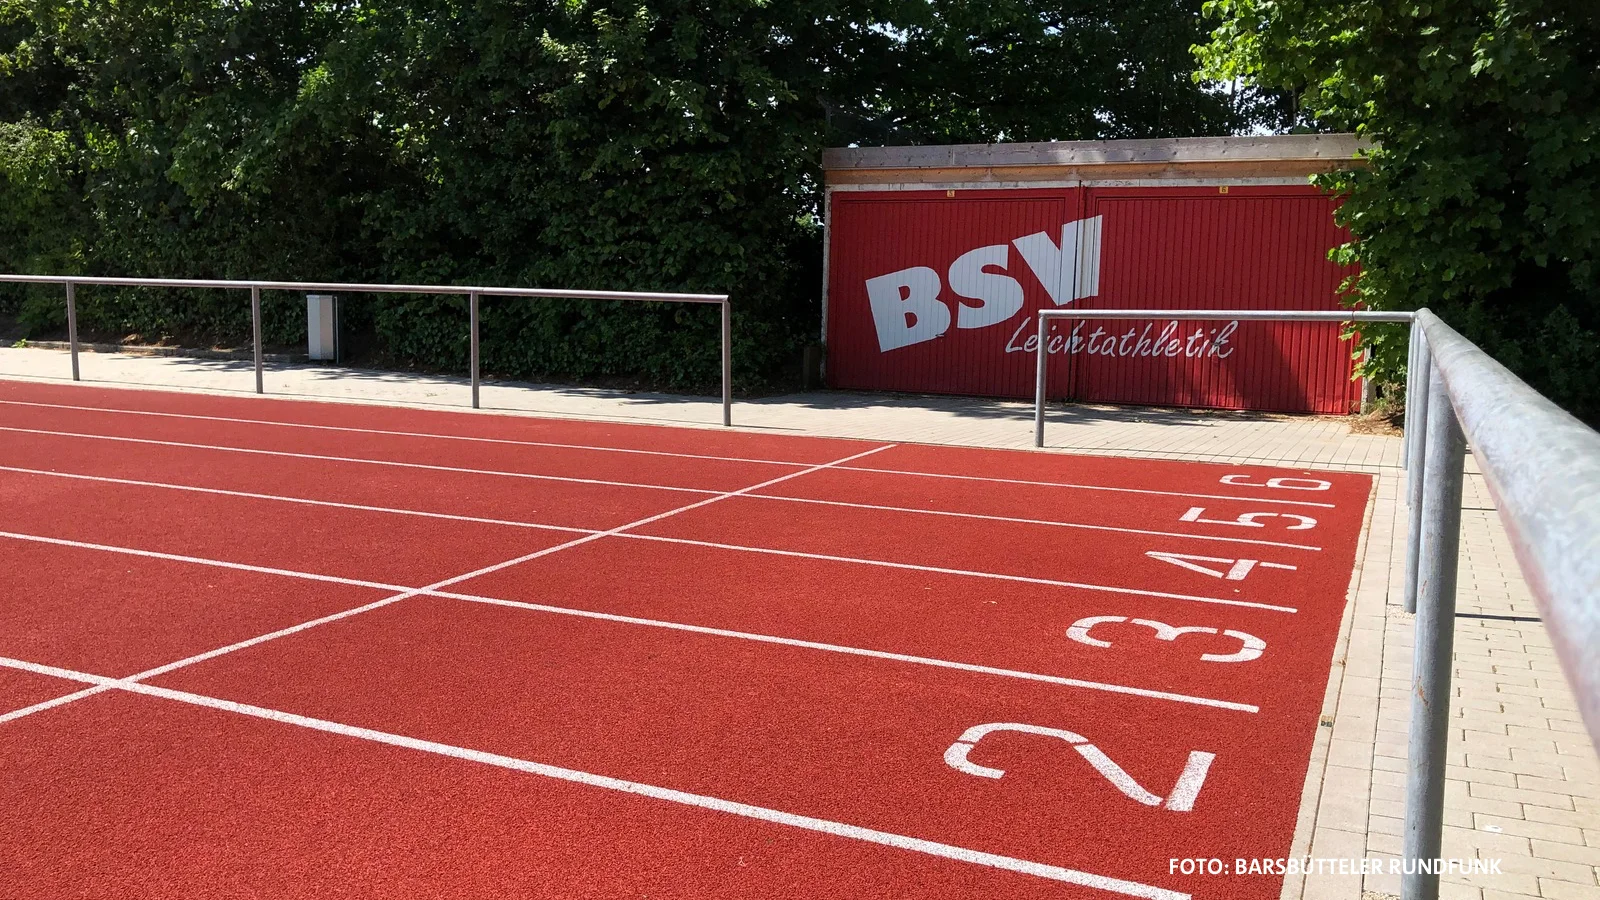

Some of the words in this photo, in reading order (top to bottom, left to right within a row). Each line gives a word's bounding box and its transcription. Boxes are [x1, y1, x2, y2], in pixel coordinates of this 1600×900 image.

[865, 214, 1103, 353] BSV
[1219, 474, 1332, 491] 6
[1179, 507, 1318, 530] 5
[1145, 551, 1298, 581] 4
[1066, 615, 1267, 663] 3
[943, 722, 1216, 813] 2
